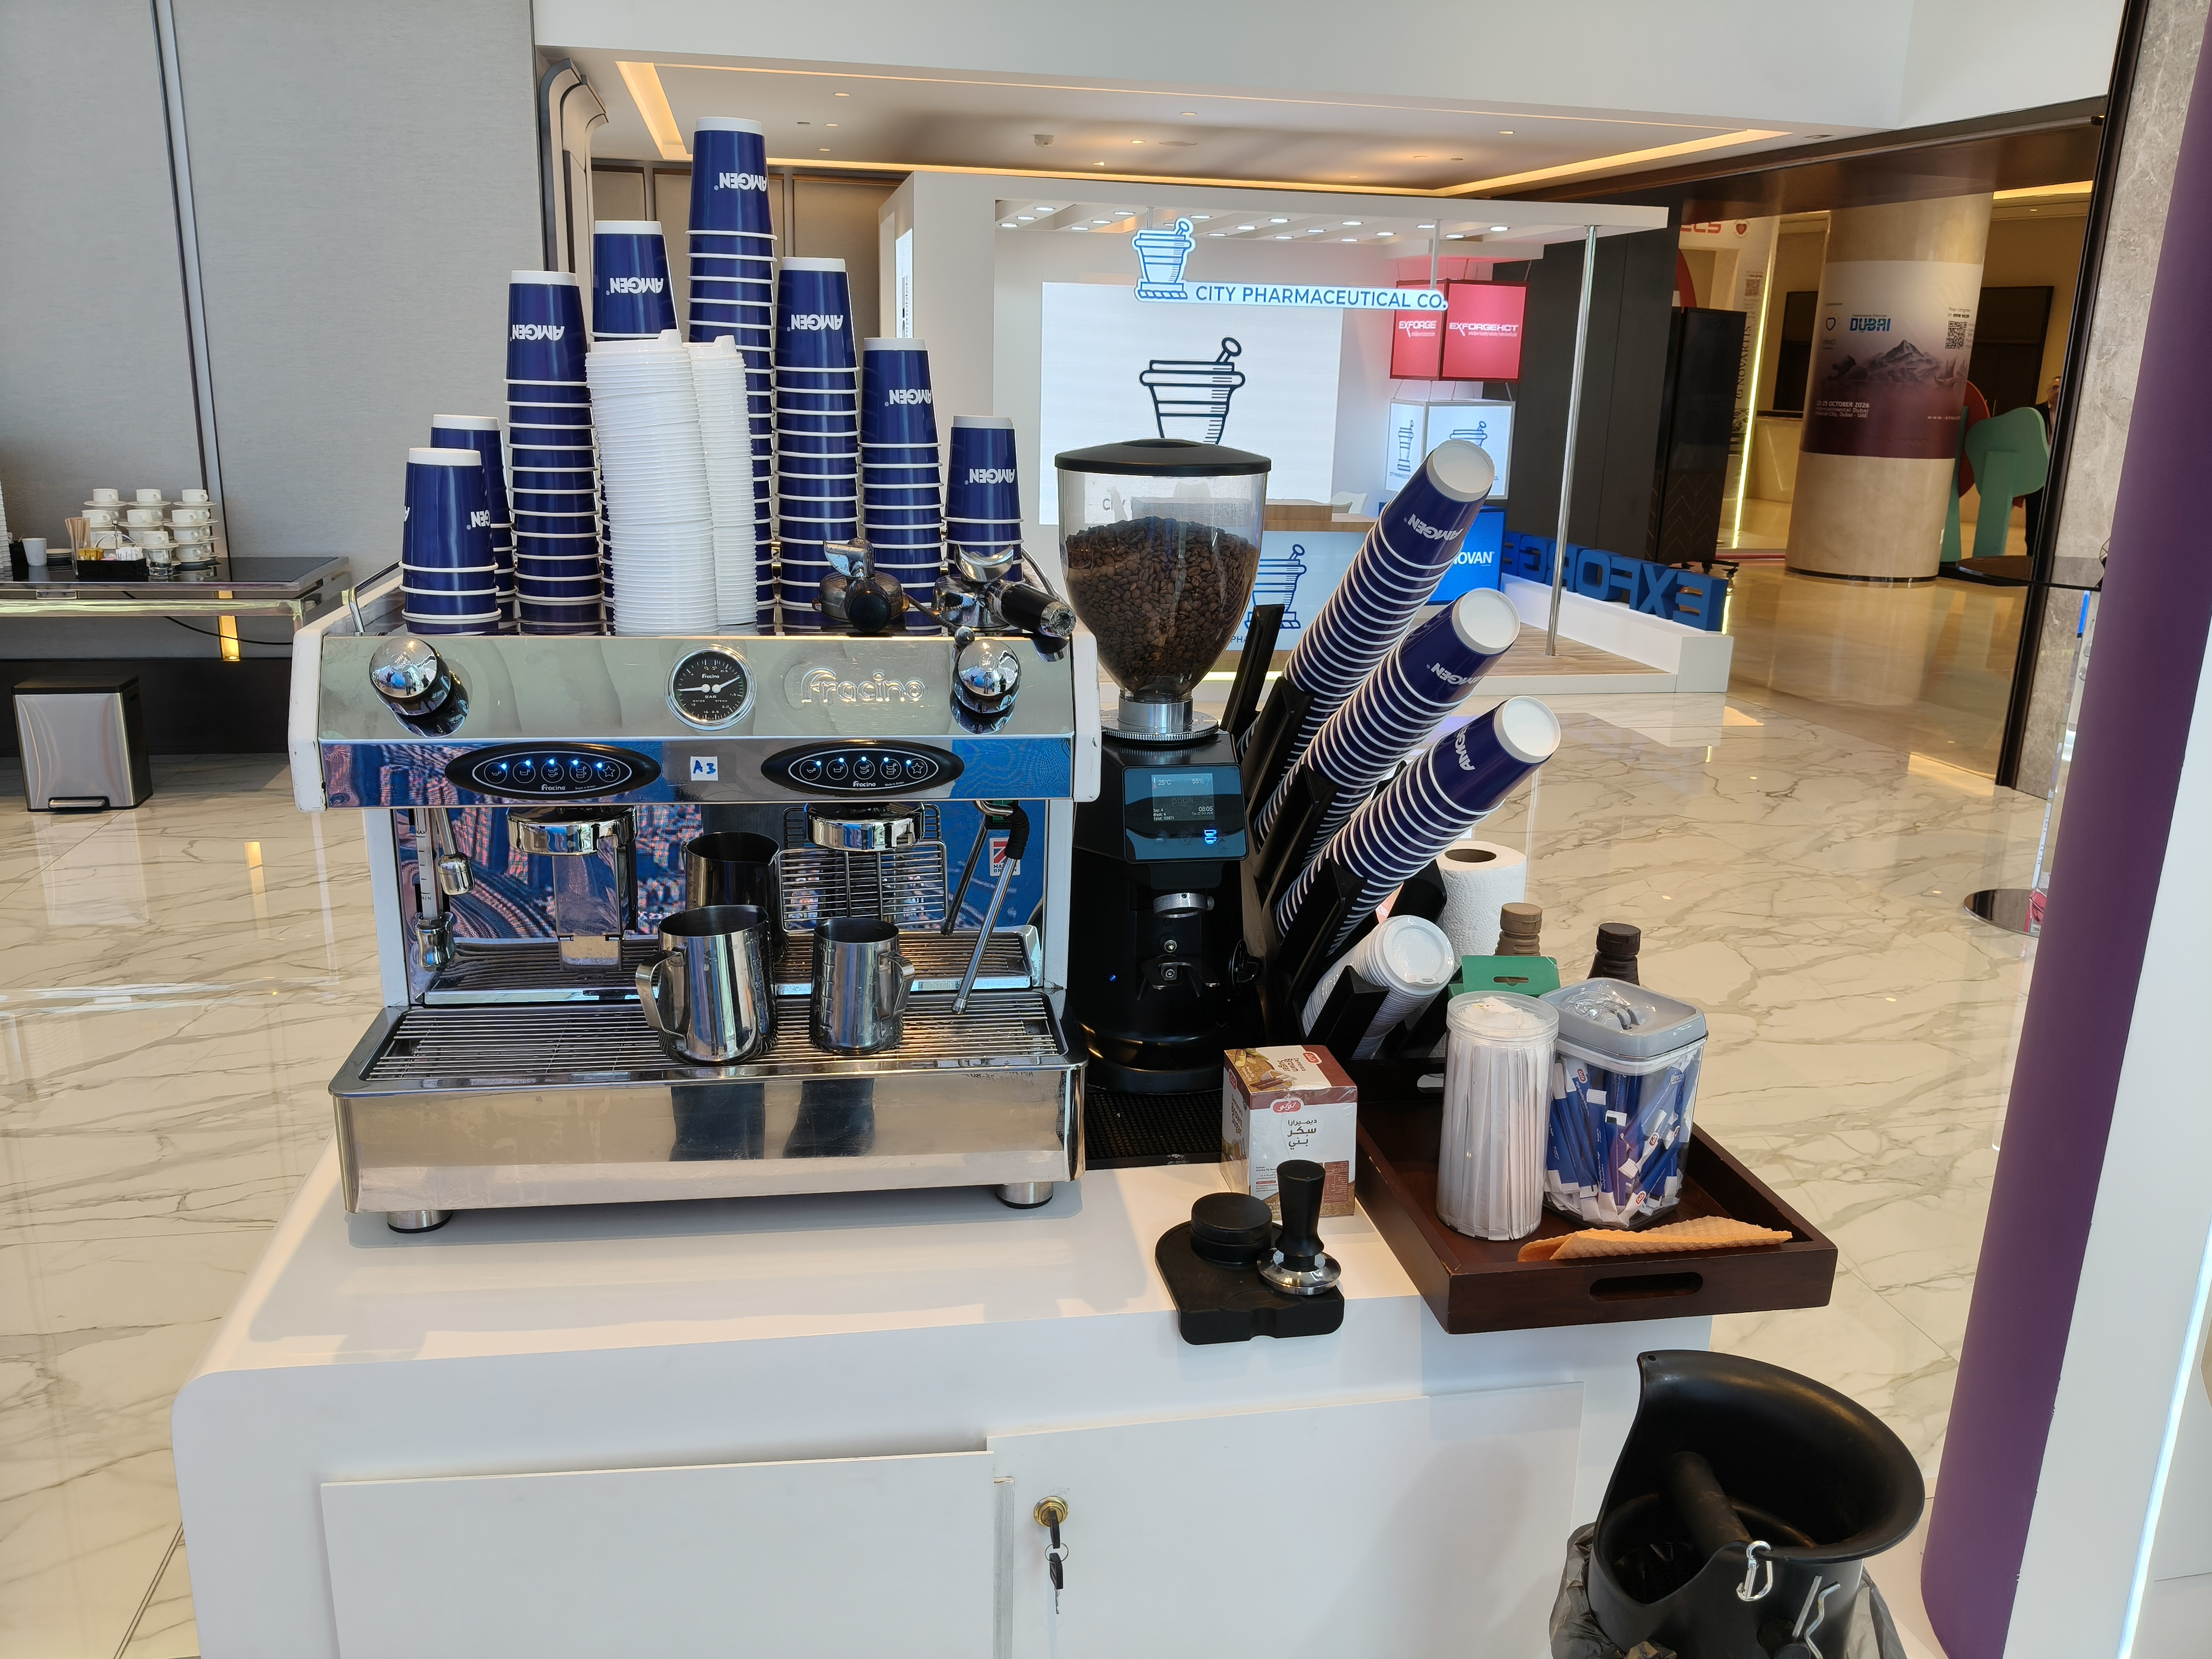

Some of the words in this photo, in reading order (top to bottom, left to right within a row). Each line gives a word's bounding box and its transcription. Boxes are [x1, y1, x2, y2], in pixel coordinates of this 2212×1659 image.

[719, 172, 767, 191] AMGEN
[610, 277, 664, 294] AMGEN
[1196, 286, 1237, 302] CITY
[1243, 287, 1412, 308] PHARMACEUTICAL
[1417, 293, 1447, 309] CO.
[791, 314, 844, 331] AMGEN
[1850, 317, 1891, 333] DUBAI
[512, 324, 565, 341] AMGEN
[889, 389, 932, 405] AMGEN
[969, 468, 1015, 484] AMGEN
[1407, 514, 1461, 541] AMGEN
[1431, 662, 1486, 685] AMGEN
[801, 667, 927, 704] Fracino
[1454, 725, 1475, 771] AMGE
[692, 759, 717, 776] A3
[1287, 1126, 1317, 1138] سكر
